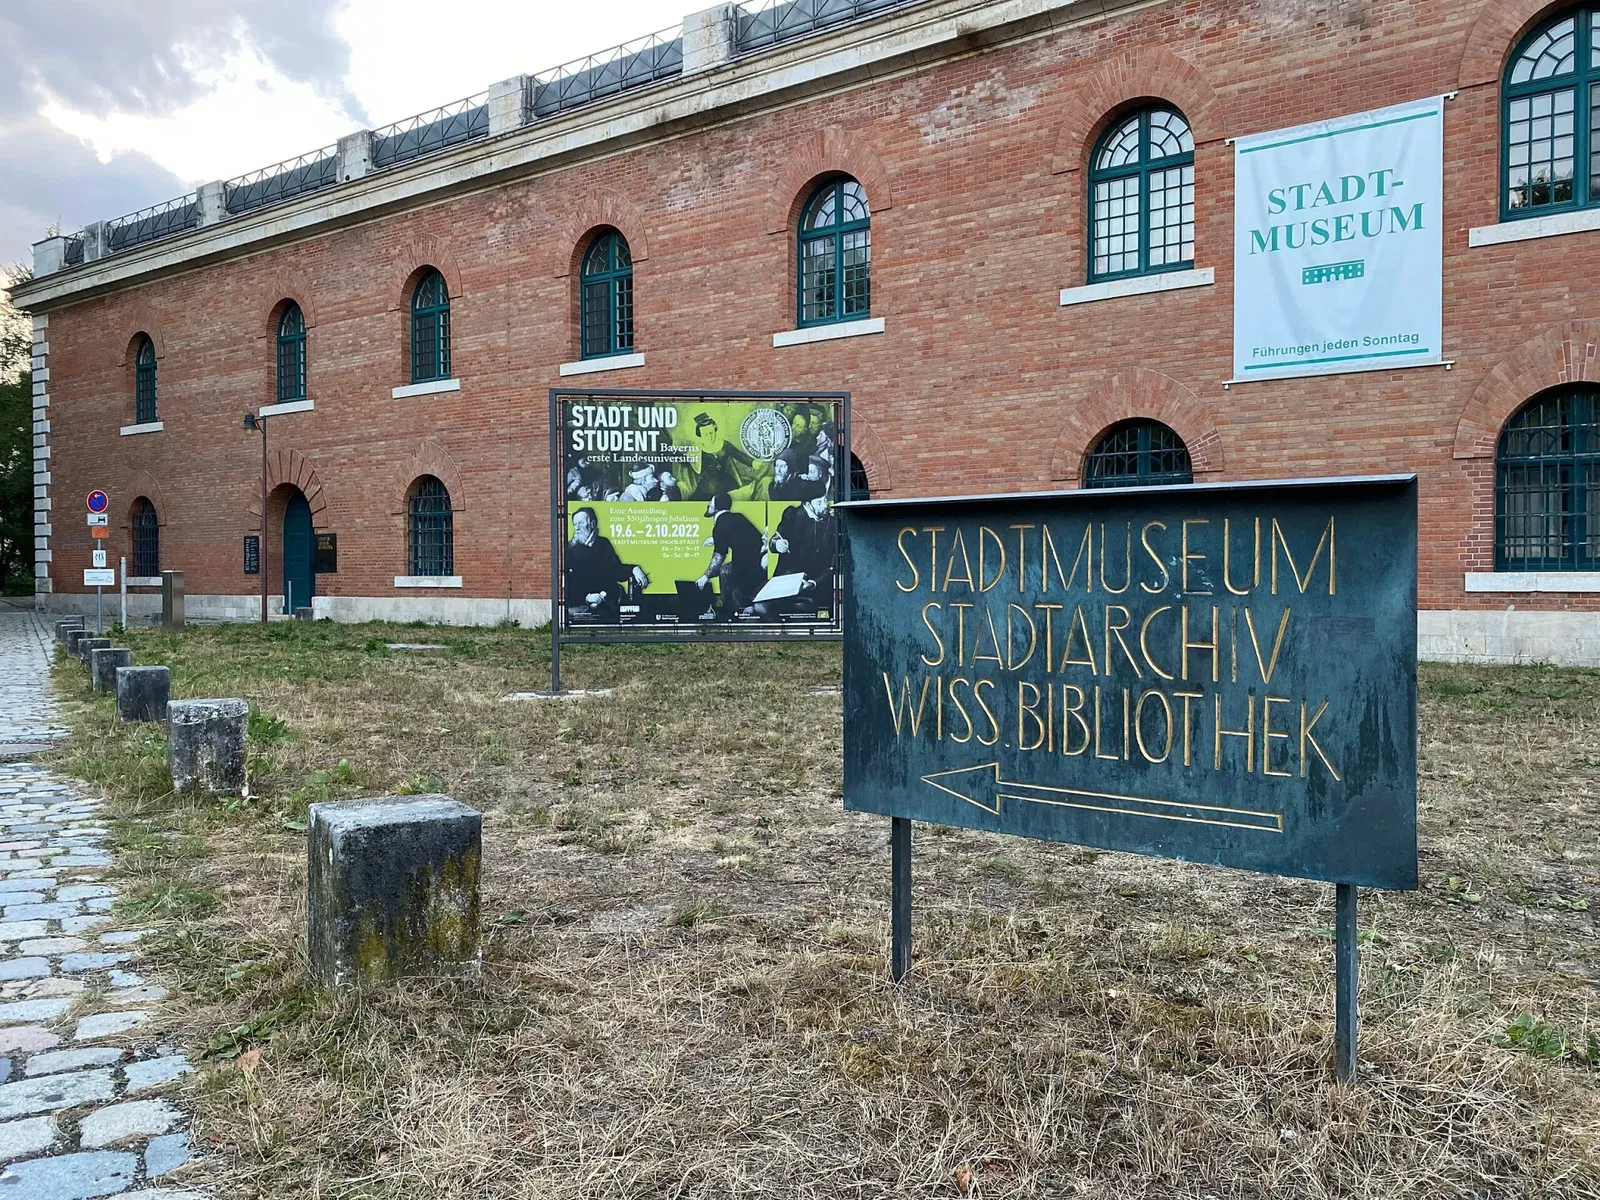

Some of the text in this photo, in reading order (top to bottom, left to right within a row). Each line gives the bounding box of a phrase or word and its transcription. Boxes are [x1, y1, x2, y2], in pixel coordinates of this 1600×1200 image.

[1267, 168, 1404, 216] STADT-
[1248, 202, 1426, 255] MUSEUM
[1252, 332, 1420, 358] Führungen jeden Sonntag
[572, 405, 678, 428] STADT UND
[572, 429, 699, 454] STUDENT Bayerns
[587, 453, 699, 463] erste Landesuniversität
[628, 507, 667, 516] Ausstellung
[668, 515, 700, 523] Jubiläum
[894, 515, 1337, 596] STADTMUSEUM
[920, 601, 1291, 684] STADTARCHIV
